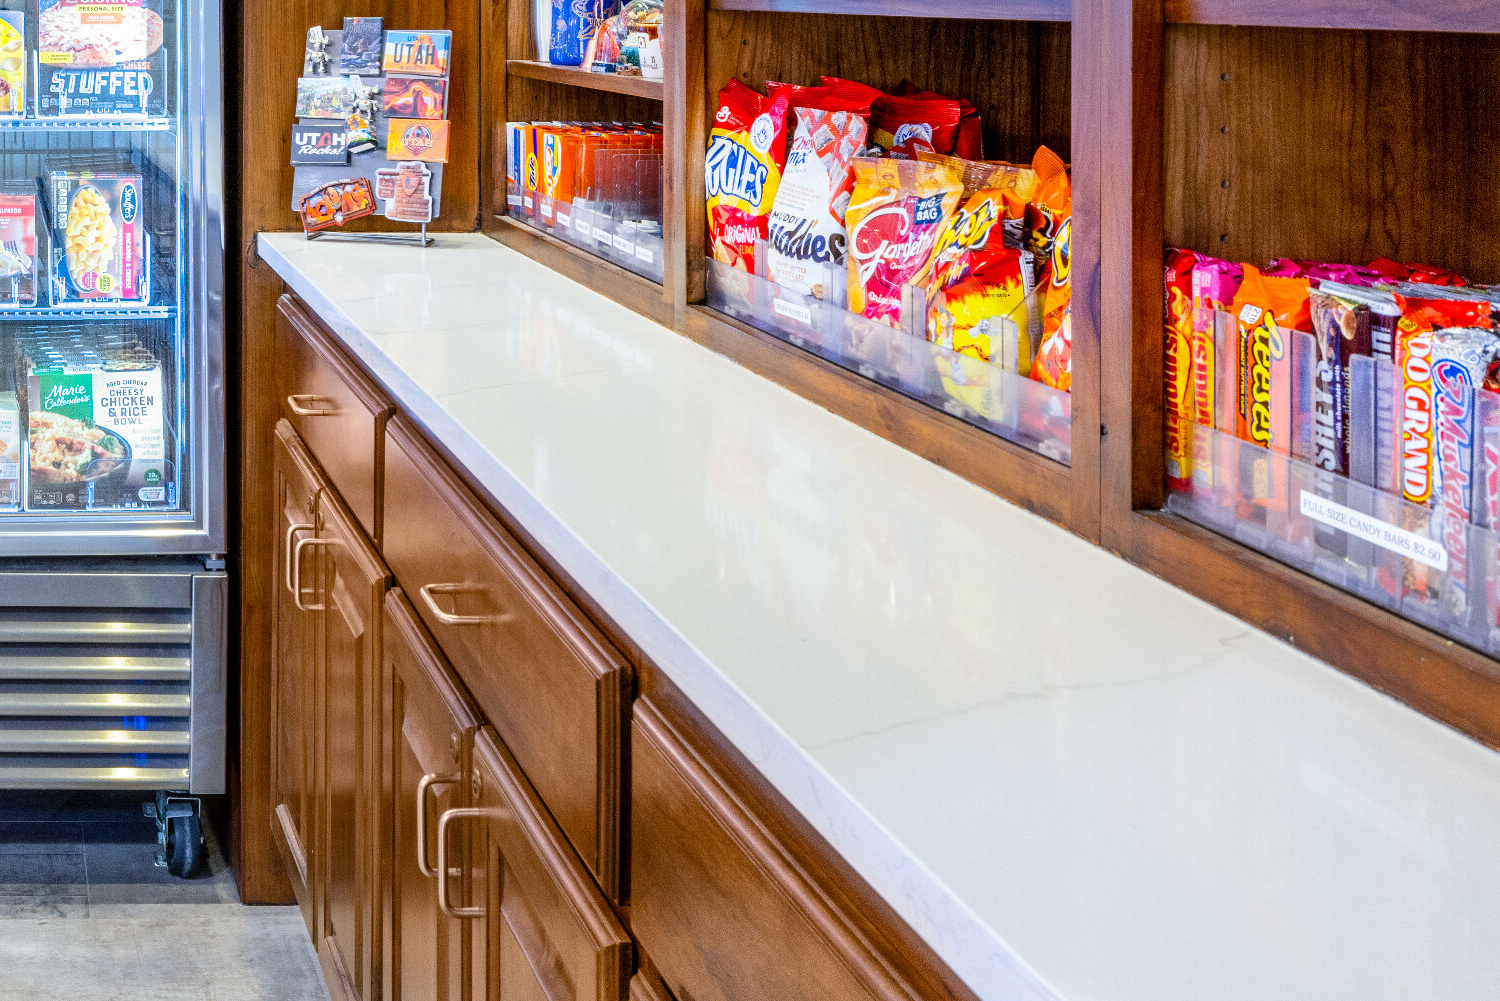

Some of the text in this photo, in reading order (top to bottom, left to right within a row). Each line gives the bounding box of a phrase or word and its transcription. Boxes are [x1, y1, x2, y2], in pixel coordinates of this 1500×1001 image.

[394, 43, 436, 66] UTAH
[50, 70, 153, 96] STUFFED
[295, 132, 346, 148] UTAH
[298, 145, 344, 156] Rocks!
[123, 186, 134, 219] Stouffer's
[919, 197, 937, 211] BIG
[772, 210, 800, 226] MUDDY
[916, 208, 938, 221] BAG
[48, 384, 87, 400] Marie
[109, 388, 145, 397] CHEESY
[44, 395, 91, 410] Callender's
[100, 396, 155, 408] CHICKEN
[108, 406, 148, 417] & RICE
[113, 417, 144, 426] BOWL
[1404, 386, 1431, 497] GRAND
[1303, 496, 1441, 562] FULL SIZE CANDY BARS $2.50
